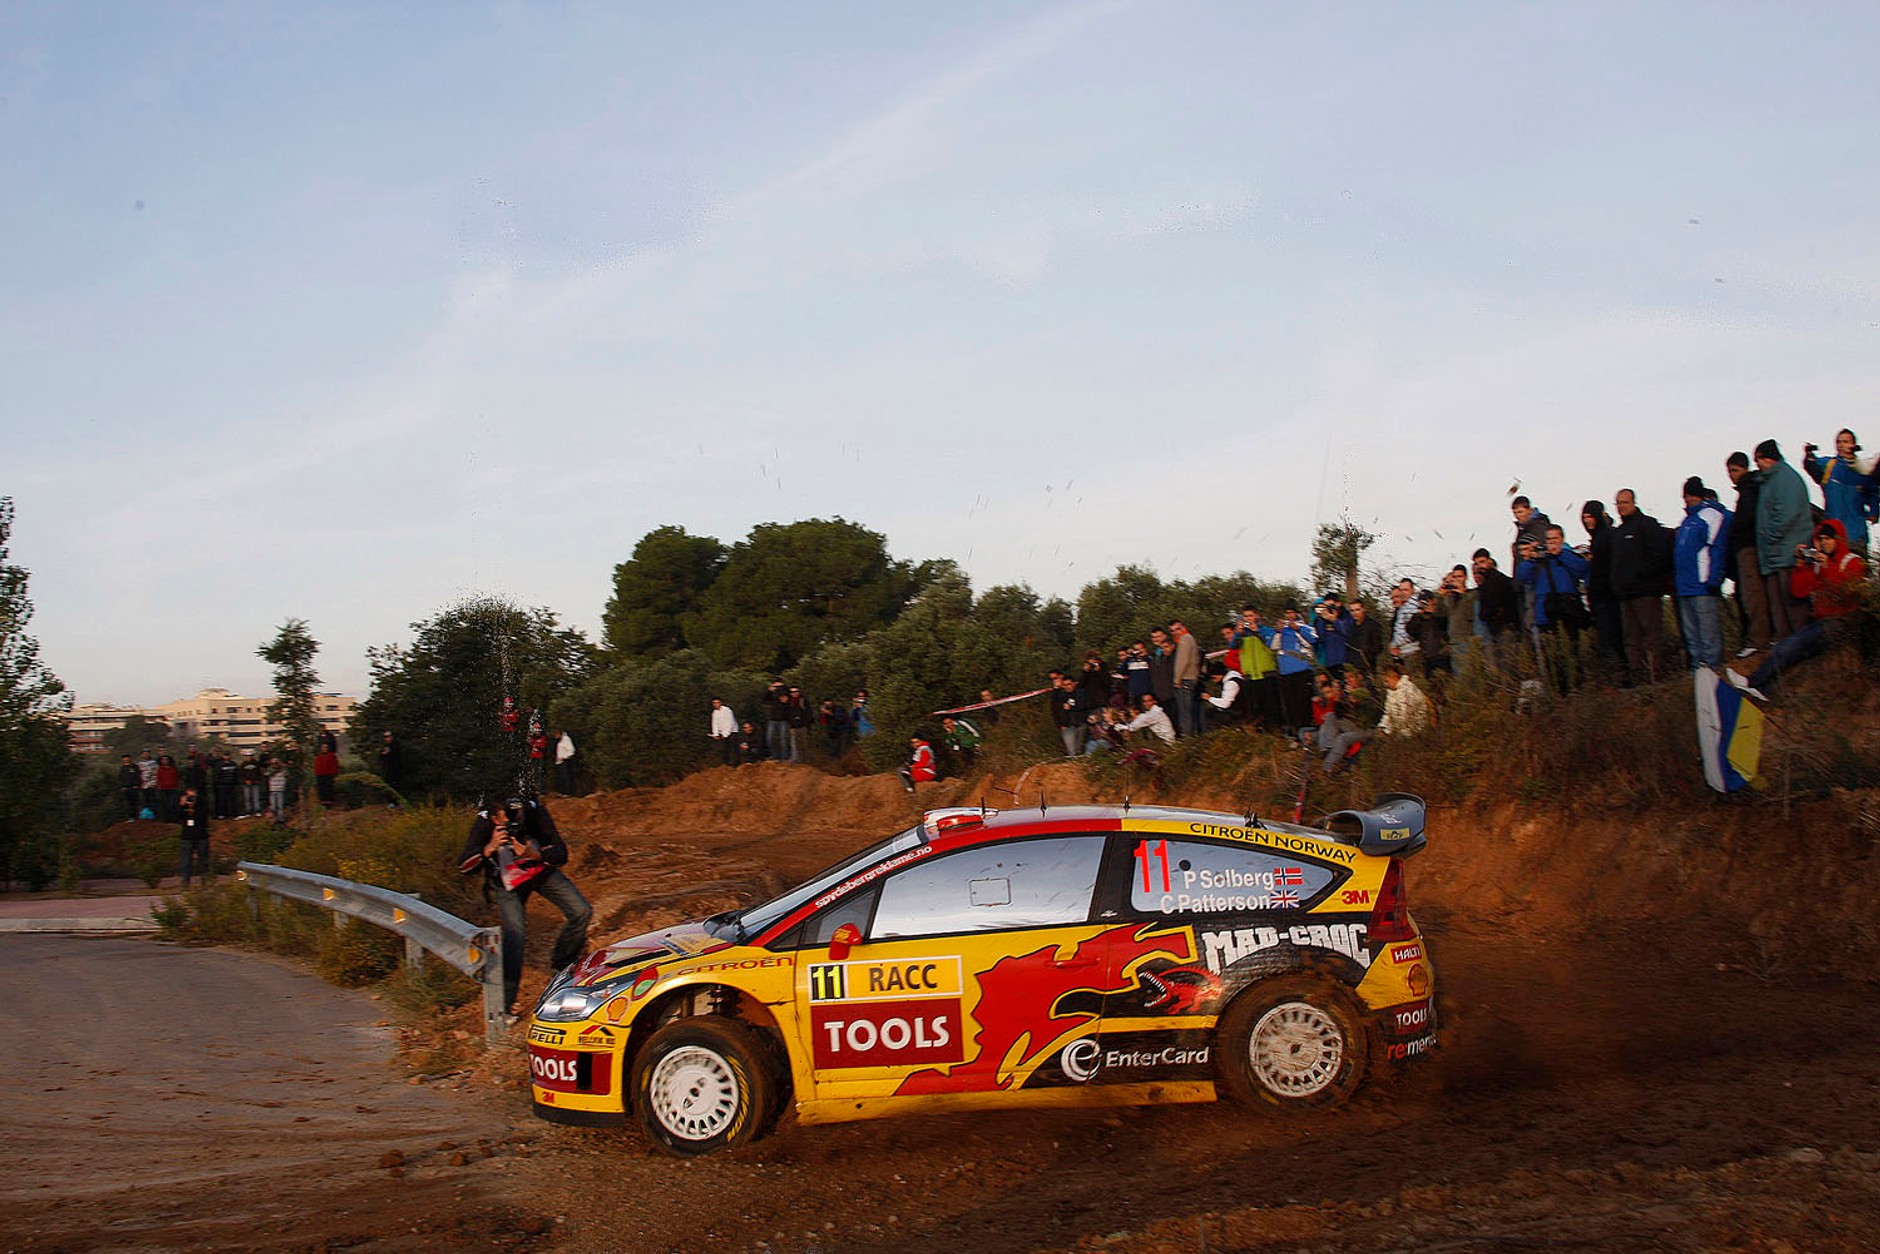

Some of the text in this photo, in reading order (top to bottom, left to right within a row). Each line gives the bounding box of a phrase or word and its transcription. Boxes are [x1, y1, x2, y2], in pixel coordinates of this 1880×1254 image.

[1190, 823, 1357, 864] CITROËN NORWAY
[1133, 839, 1170, 893] 11
[1184, 868, 1274, 890] P Solberg
[1160, 892, 1270, 914] C Patterson
[1342, 889, 1369, 905] 3M
[1202, 923, 1370, 975] MAD-CROC
[812, 965, 841, 999] 11
[869, 964, 938, 992] RACC
[1396, 1007, 1427, 1029] TOOLS
[823, 1015, 950, 1052] TOOLS
[1105, 1046, 1209, 1068] EnterCard
